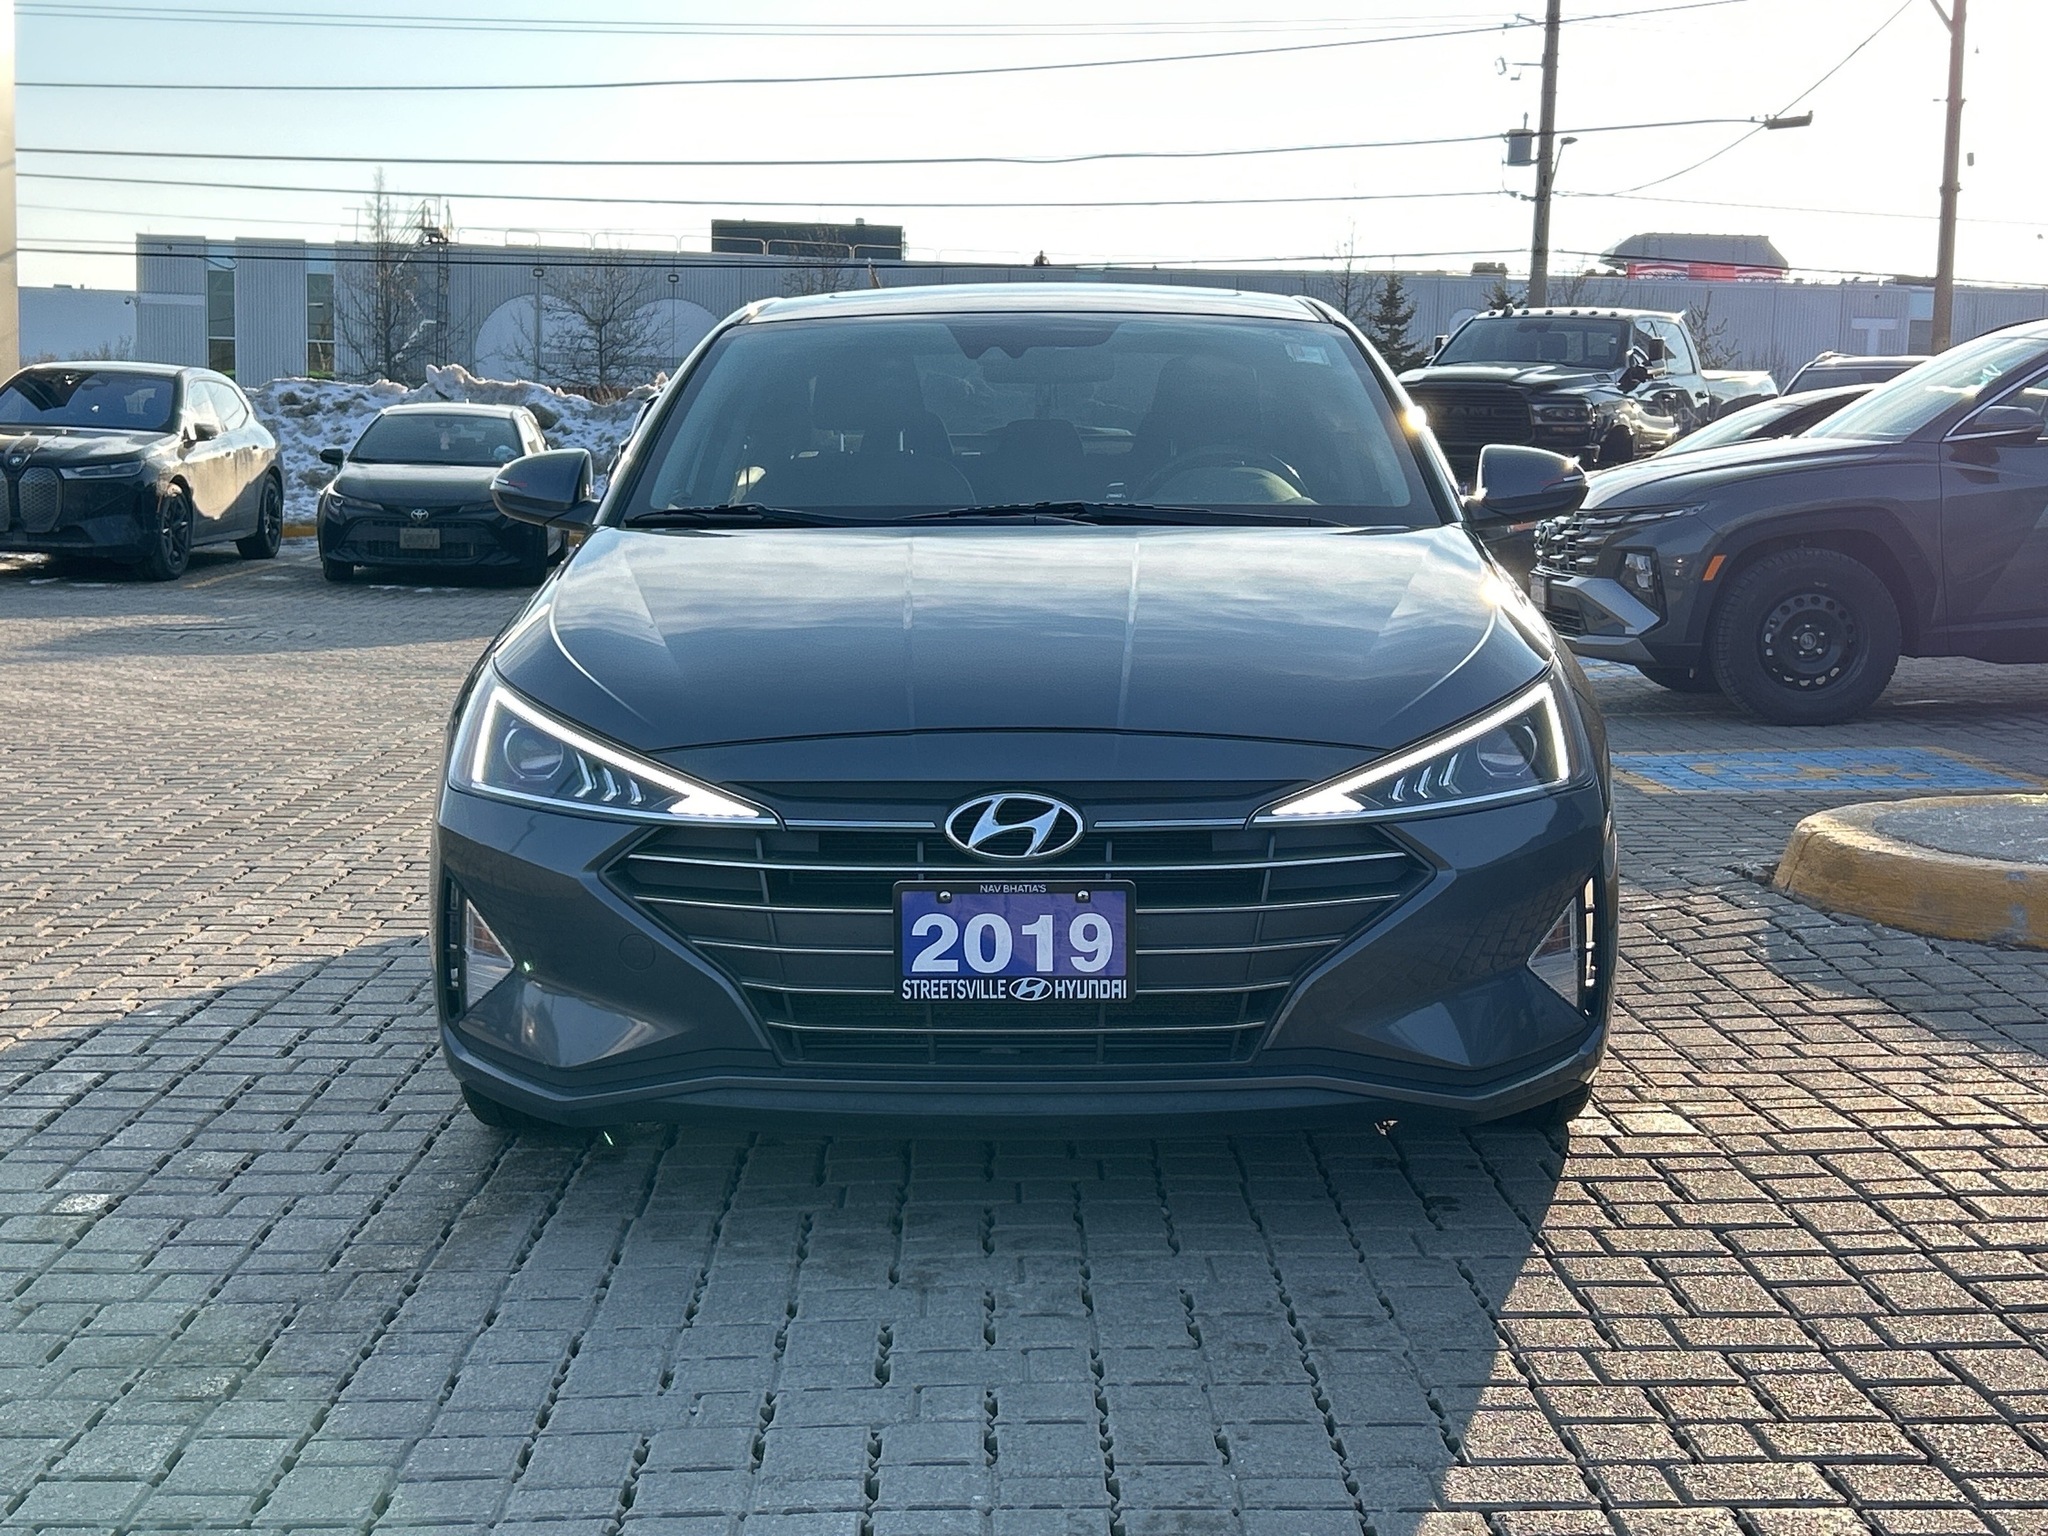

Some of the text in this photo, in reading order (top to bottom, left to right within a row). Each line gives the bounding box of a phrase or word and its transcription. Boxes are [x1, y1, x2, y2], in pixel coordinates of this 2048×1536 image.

[979, 884, 1047, 893] NAV BHATIA'S
[911, 913, 1113, 973] 2019
[902, 979, 1127, 1000] STREETSVILLE HYUNDAI
